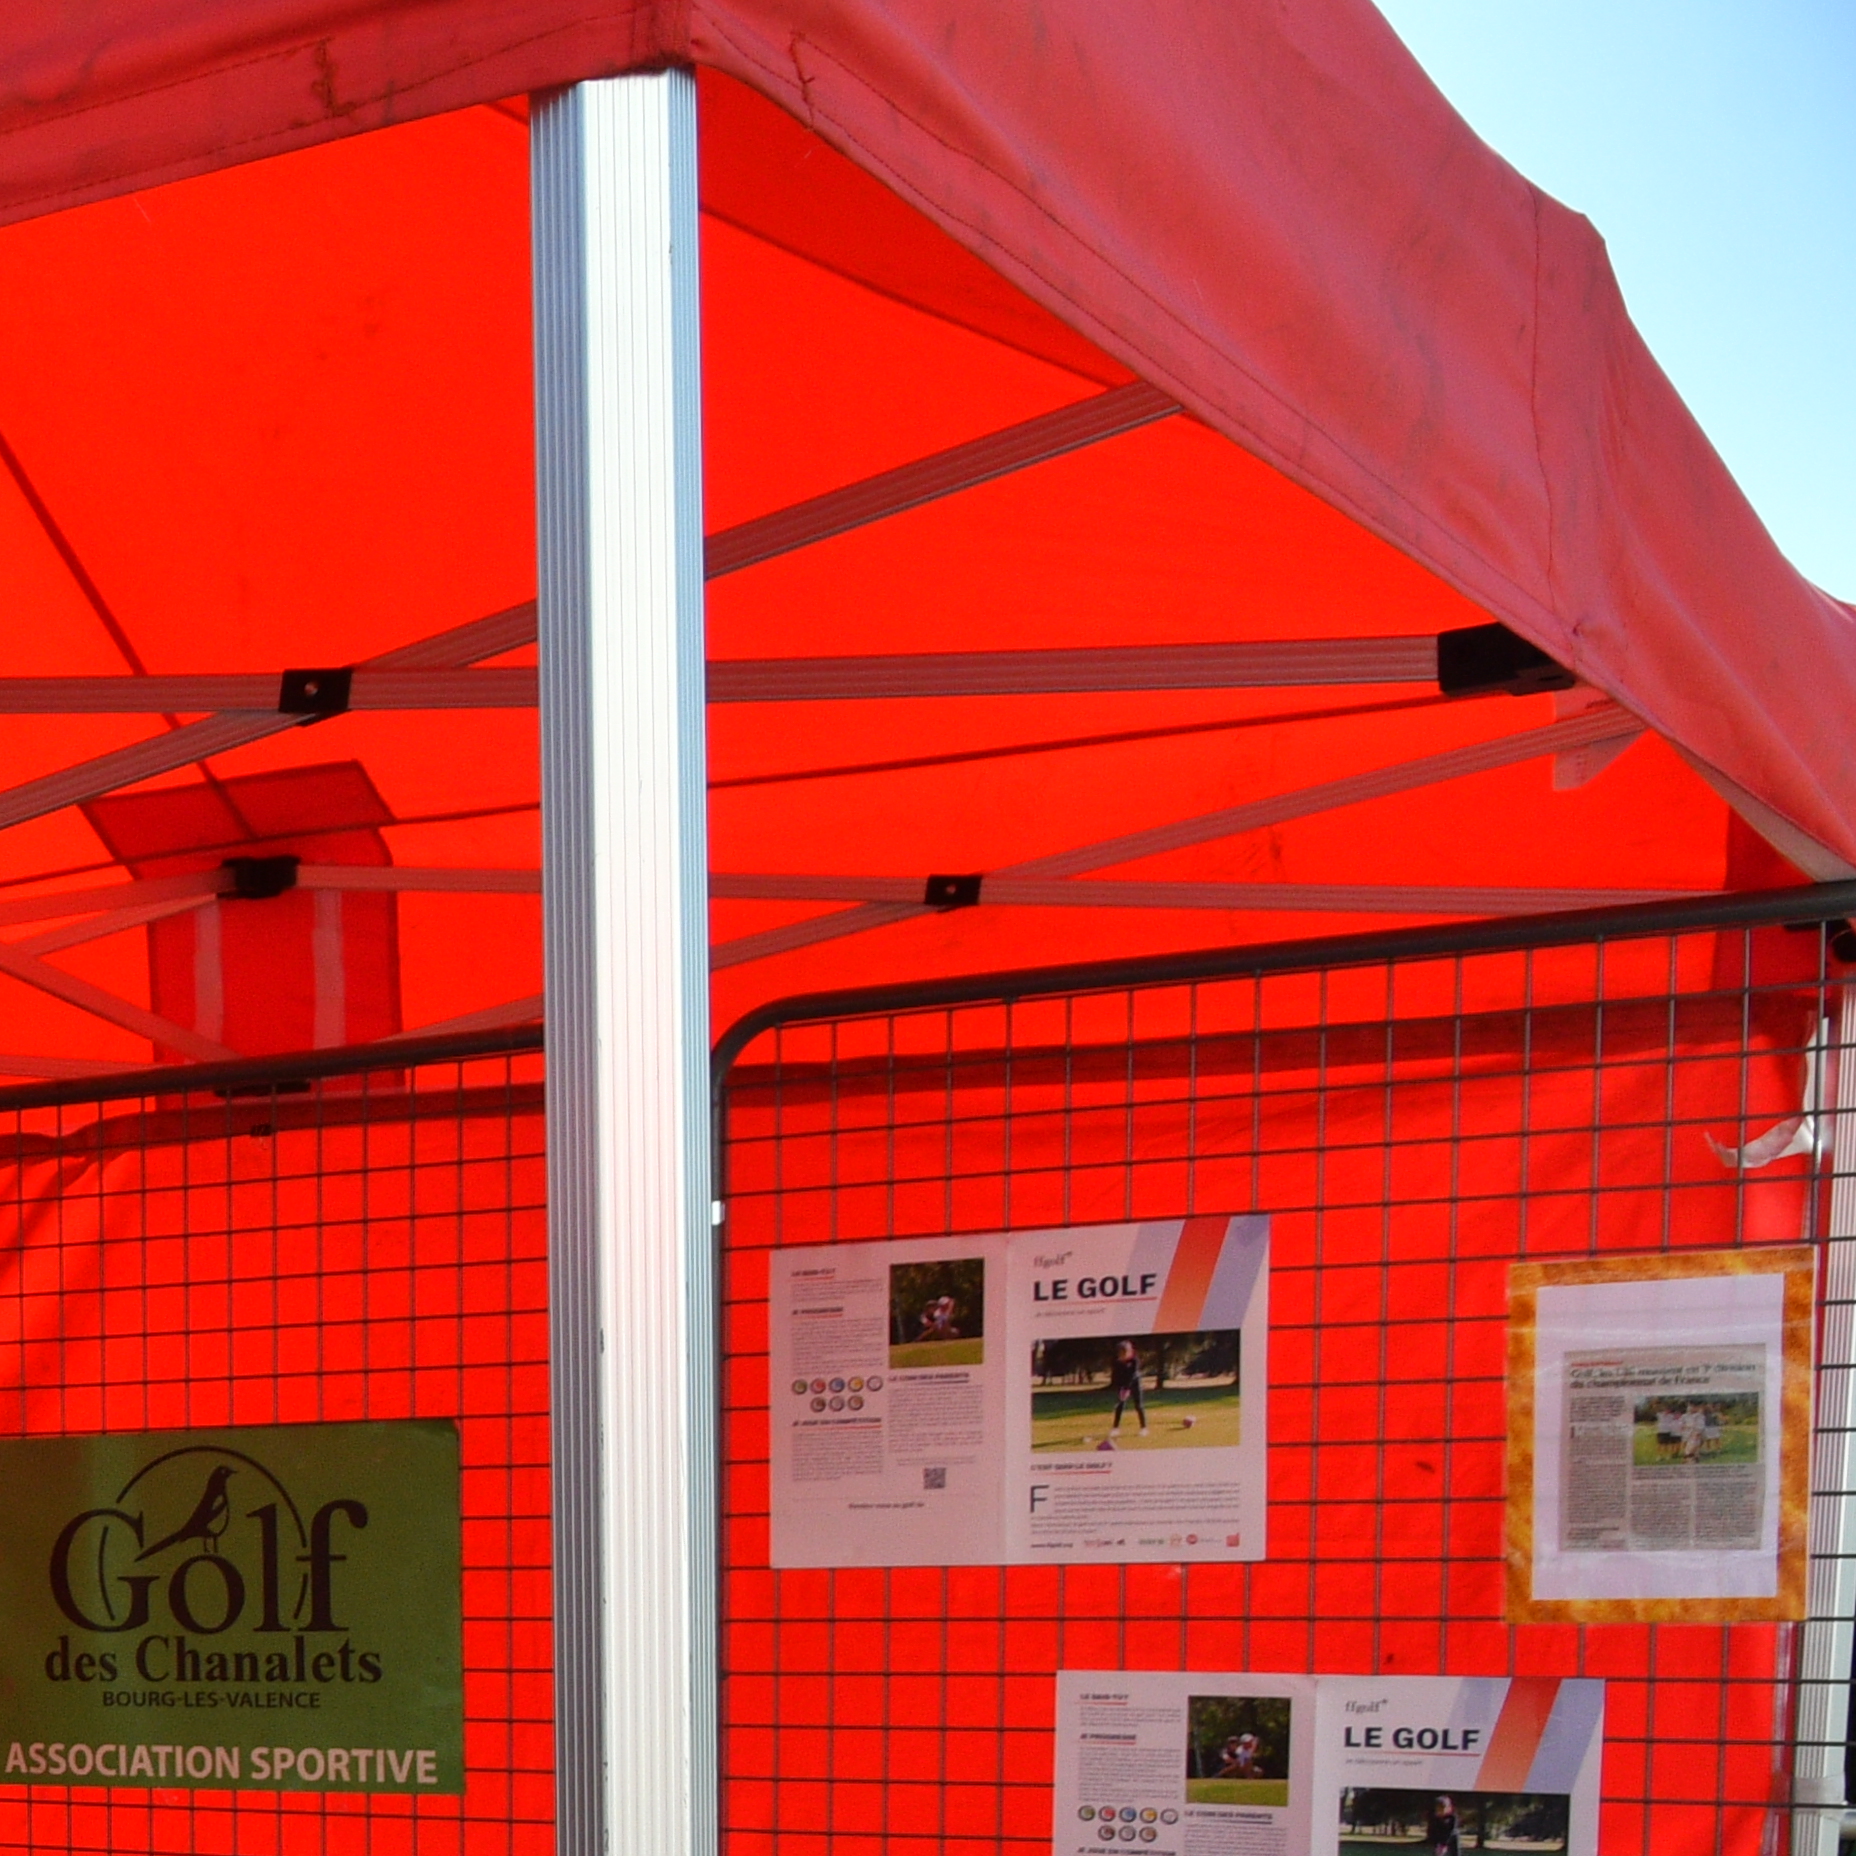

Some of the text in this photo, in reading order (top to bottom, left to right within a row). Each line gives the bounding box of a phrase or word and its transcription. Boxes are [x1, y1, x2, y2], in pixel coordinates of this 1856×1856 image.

[1033, 1273, 1157, 1302] LE GOLF
[48, 1499, 369, 1635] Golf
[44, 1634, 383, 1684] des Chanalets
[102, 1690, 320, 1709] BOURG-LES-VALENCE
[1344, 1726, 1480, 1751] LE GOLF
[5, 1742, 438, 1785] ASSOCIATION SPORTIVE
